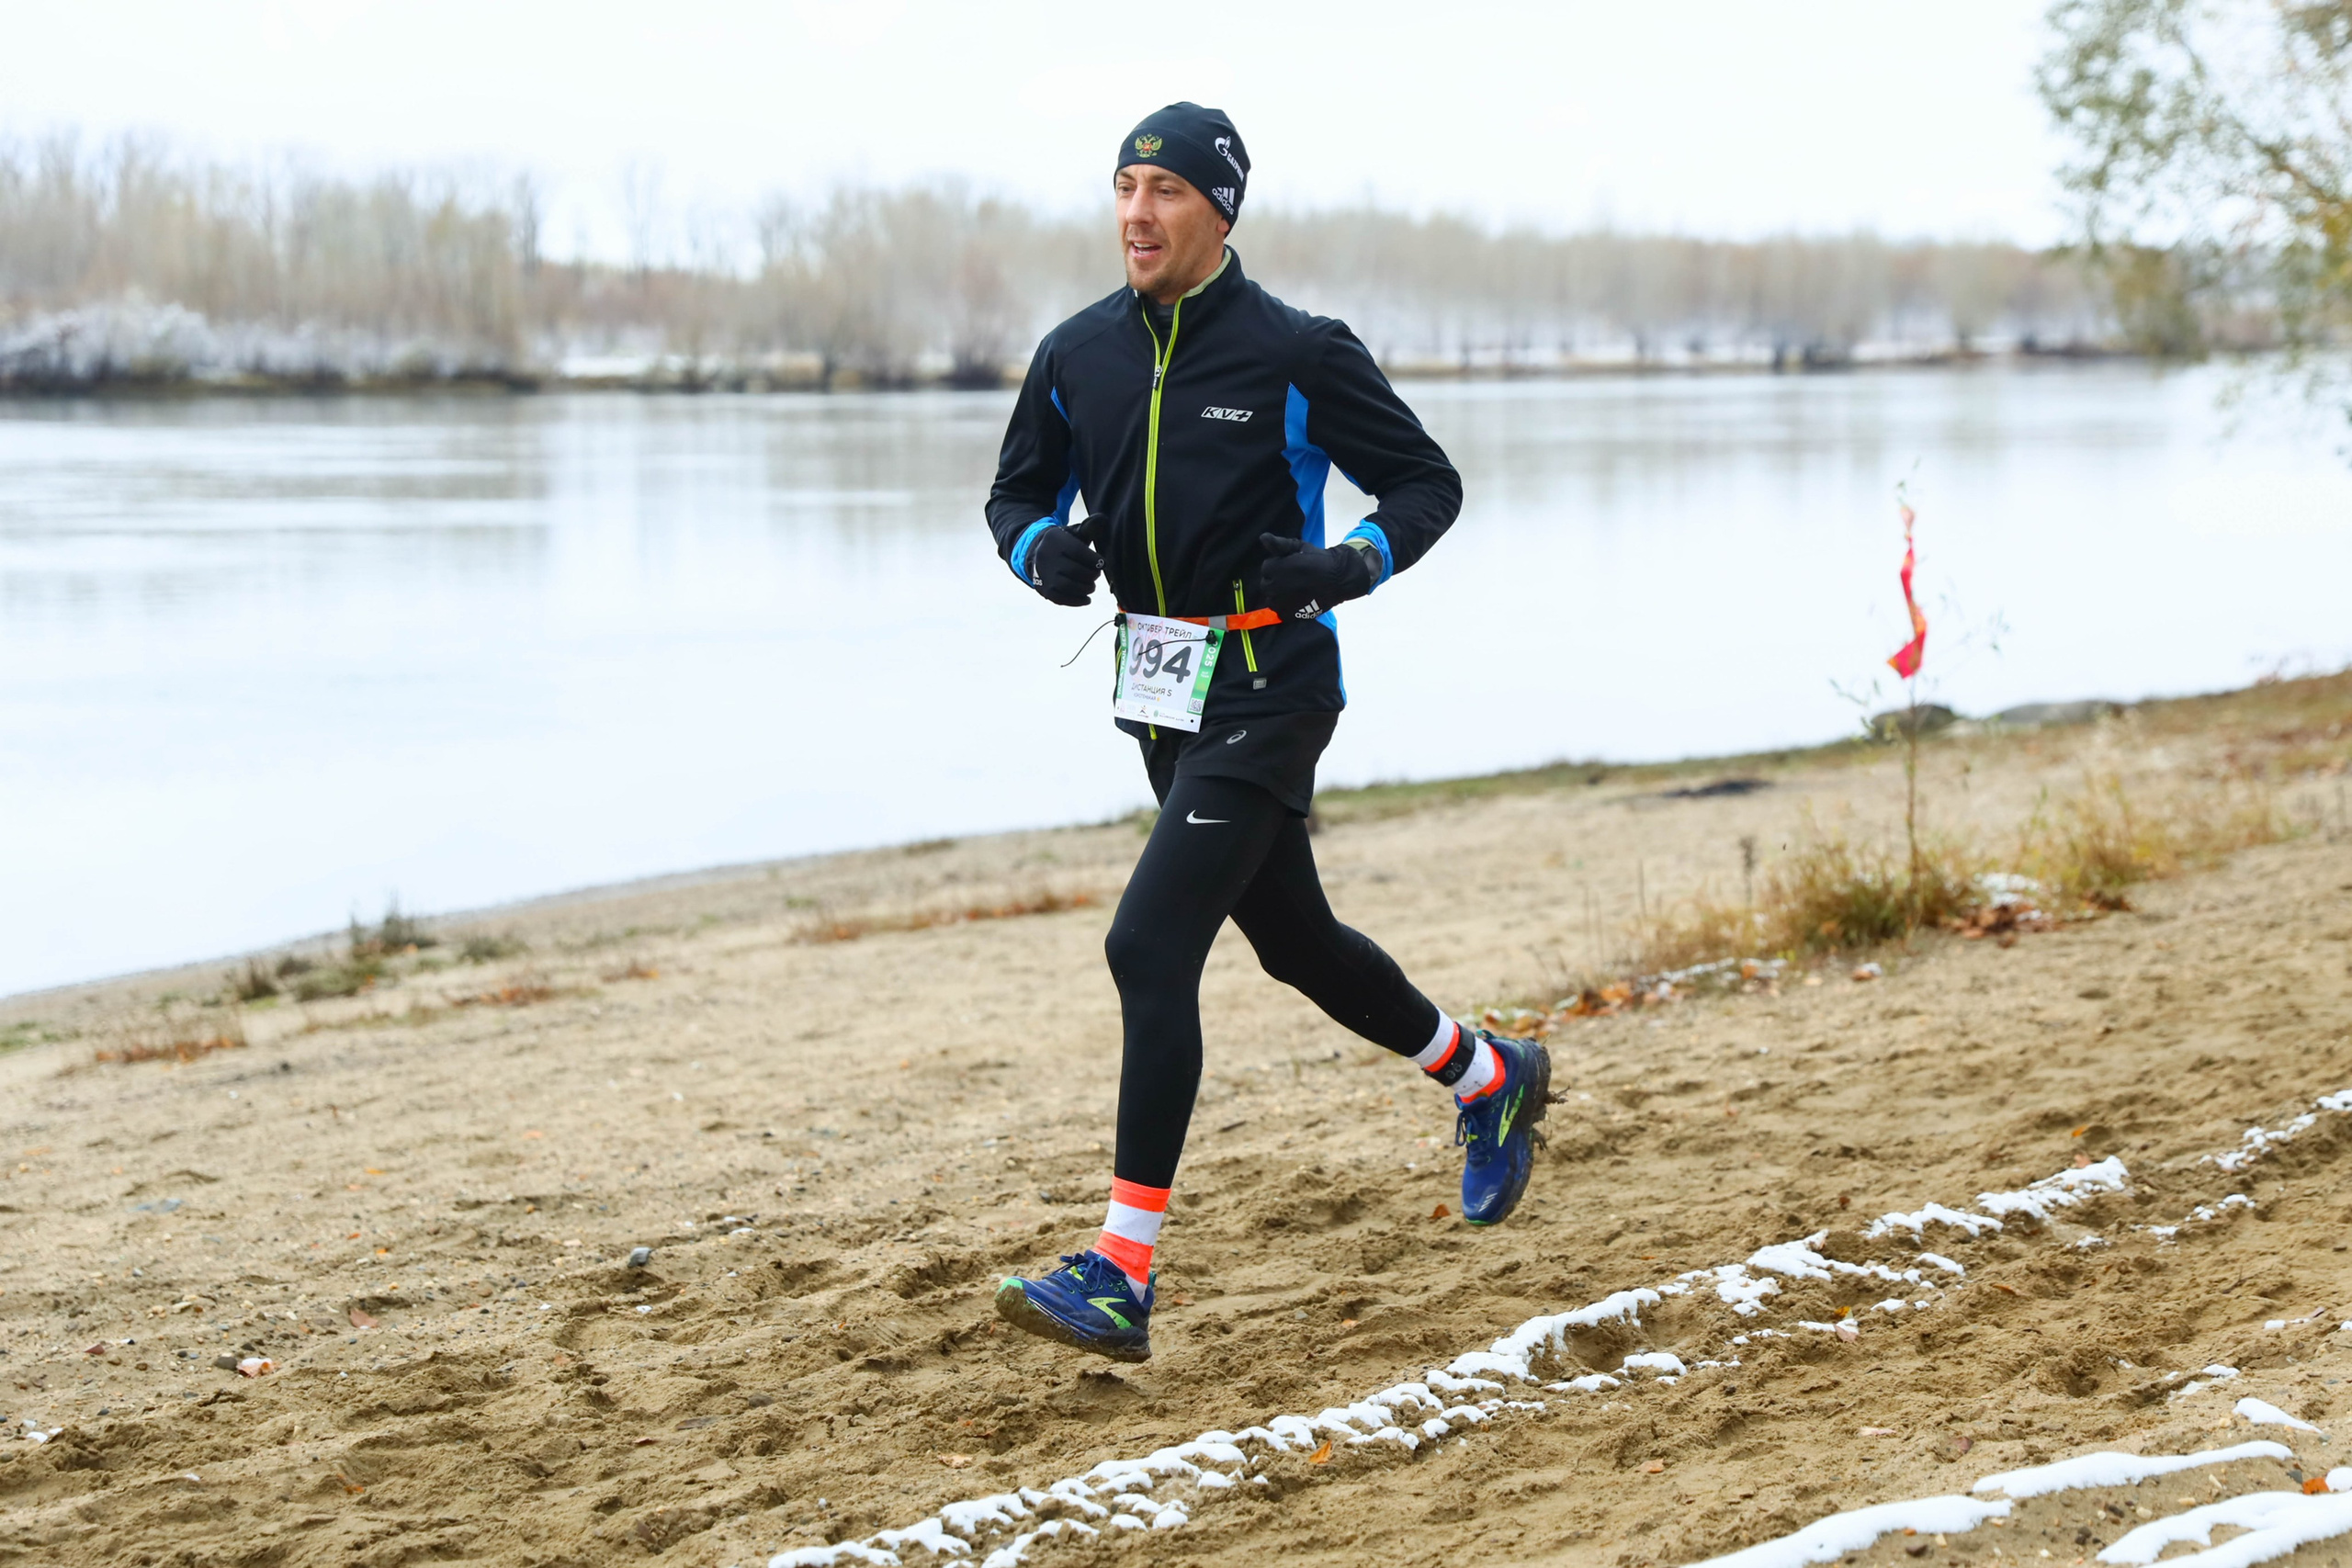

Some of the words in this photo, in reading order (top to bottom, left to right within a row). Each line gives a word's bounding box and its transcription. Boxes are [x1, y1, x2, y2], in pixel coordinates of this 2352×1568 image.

[1212, 187, 1235, 216] adidas
[1165, 626, 1193, 639] ТРЕЙЛ
[1129, 637, 1192, 683] 994
[1167, 689, 1172, 697] S
